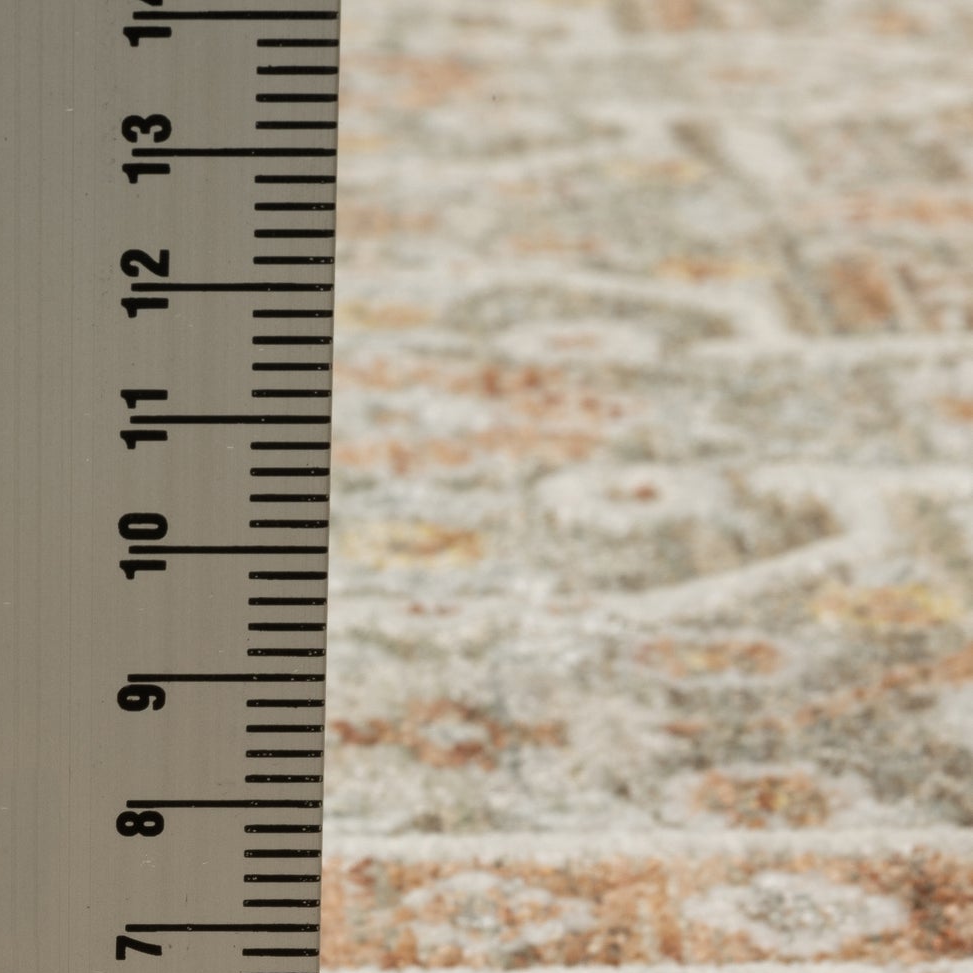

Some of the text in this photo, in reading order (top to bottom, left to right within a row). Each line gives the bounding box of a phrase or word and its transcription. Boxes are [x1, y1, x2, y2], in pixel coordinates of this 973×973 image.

[122, 0, 173, 48] 1
[121, 113, 173, 185] 13
[119, 248, 170, 319] 12
[119, 389, 169, 450] 11
[117, 512, 169, 581] 10
[116, 683, 166, 712] 9
[115, 810, 165, 838] 8
[115, 935, 163, 961] 7
